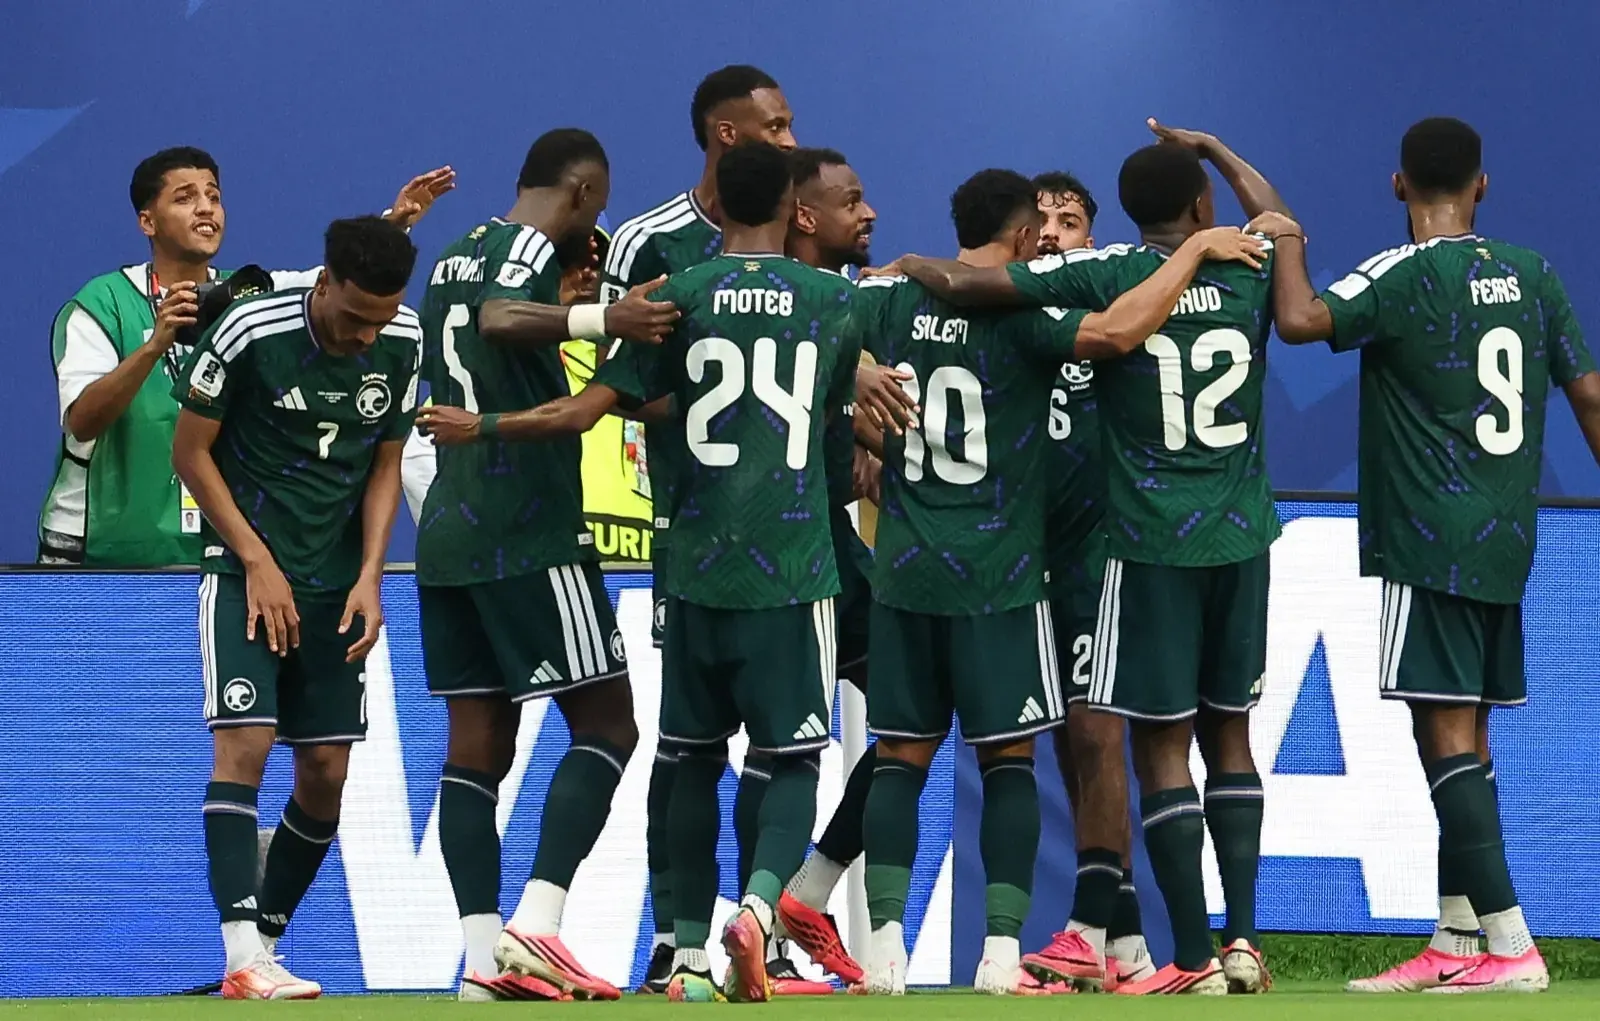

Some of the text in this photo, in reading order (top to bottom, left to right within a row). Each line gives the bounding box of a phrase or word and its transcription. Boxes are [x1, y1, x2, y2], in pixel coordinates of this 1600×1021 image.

[713, 288, 793, 317] MOTEB
[686, 337, 818, 470] 24
[894, 362, 988, 485] 10
[1145, 329, 1252, 451] 12
[1475, 326, 1524, 455] 9
[317, 421, 339, 459] 7
[584, 521, 654, 561] URI
[1072, 634, 1093, 685] 2
